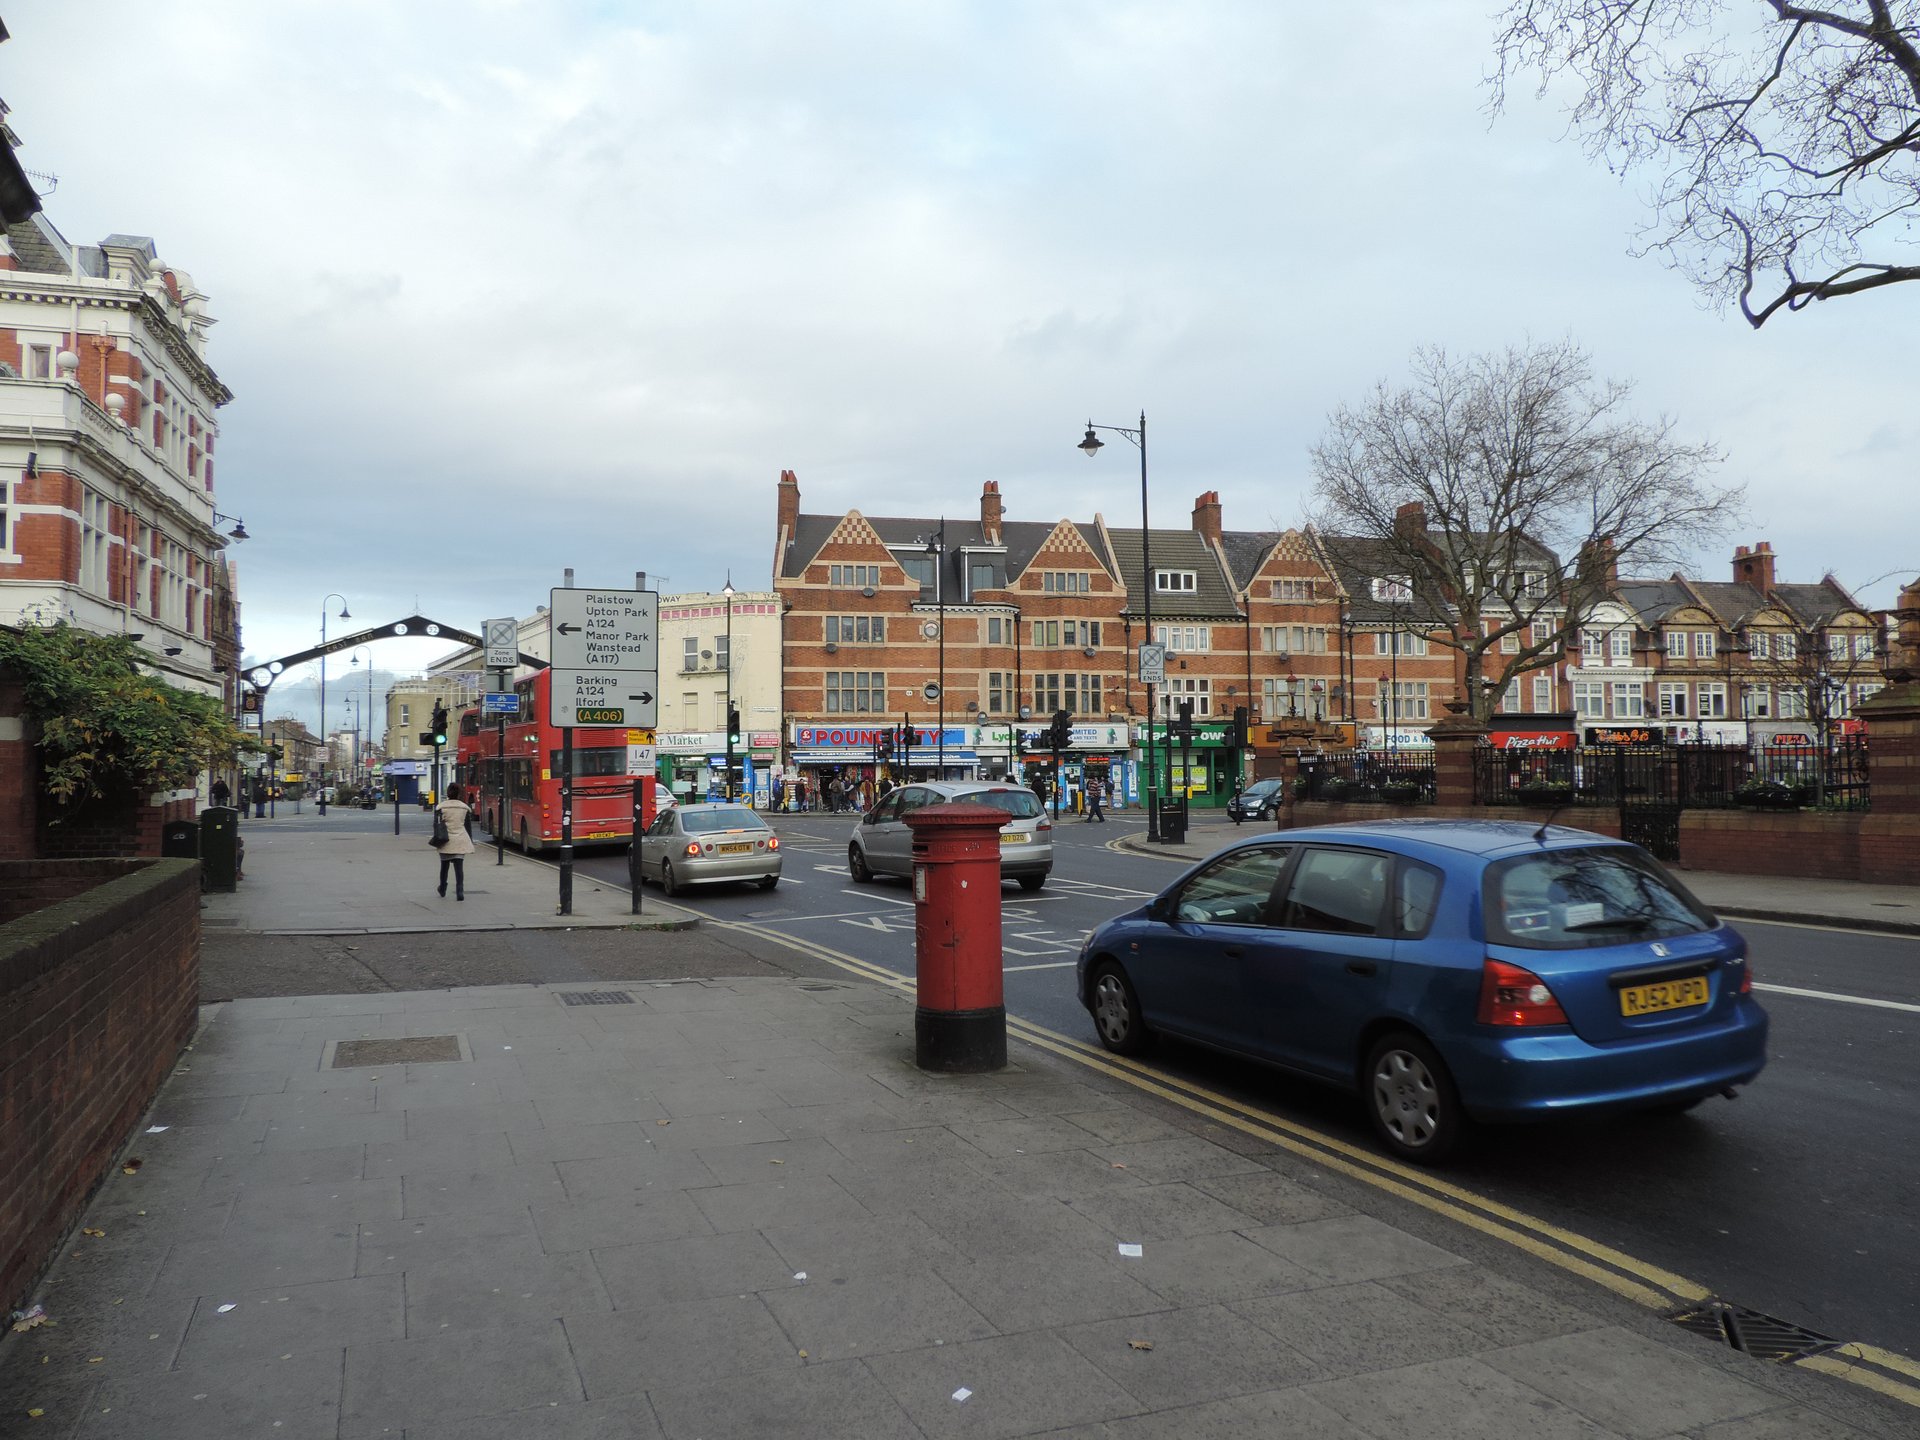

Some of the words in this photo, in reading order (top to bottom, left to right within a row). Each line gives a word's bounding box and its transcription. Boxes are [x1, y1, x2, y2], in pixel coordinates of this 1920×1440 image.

[586, 595, 634, 604] Plaistow
[586, 607, 619, 618] Upton
[624, 608, 648, 617] Park
[586, 619, 615, 628] A124
[586, 631, 620, 641] Manor
[625, 632, 649, 641] Park
[586, 643, 641, 653] Wanstead
[586, 653, 620, 665] (A117)
[576, 676, 618, 686] Barking
[576, 687, 604, 696] A124
[576, 698, 605, 707] Ilford
[577, 710, 623, 722] (A406)
[667, 736, 703, 746] Market
[893, 730, 940, 745] CTY
[1386, 734, 1410, 743] FOOD
[1504, 735, 1535, 750] Pizza
[1535, 734, 1561, 746] Hut
[634, 748, 651, 760] 147
[1627, 985, 1670, 1012] RJ52
[1671, 980, 1704, 1004] UPD
